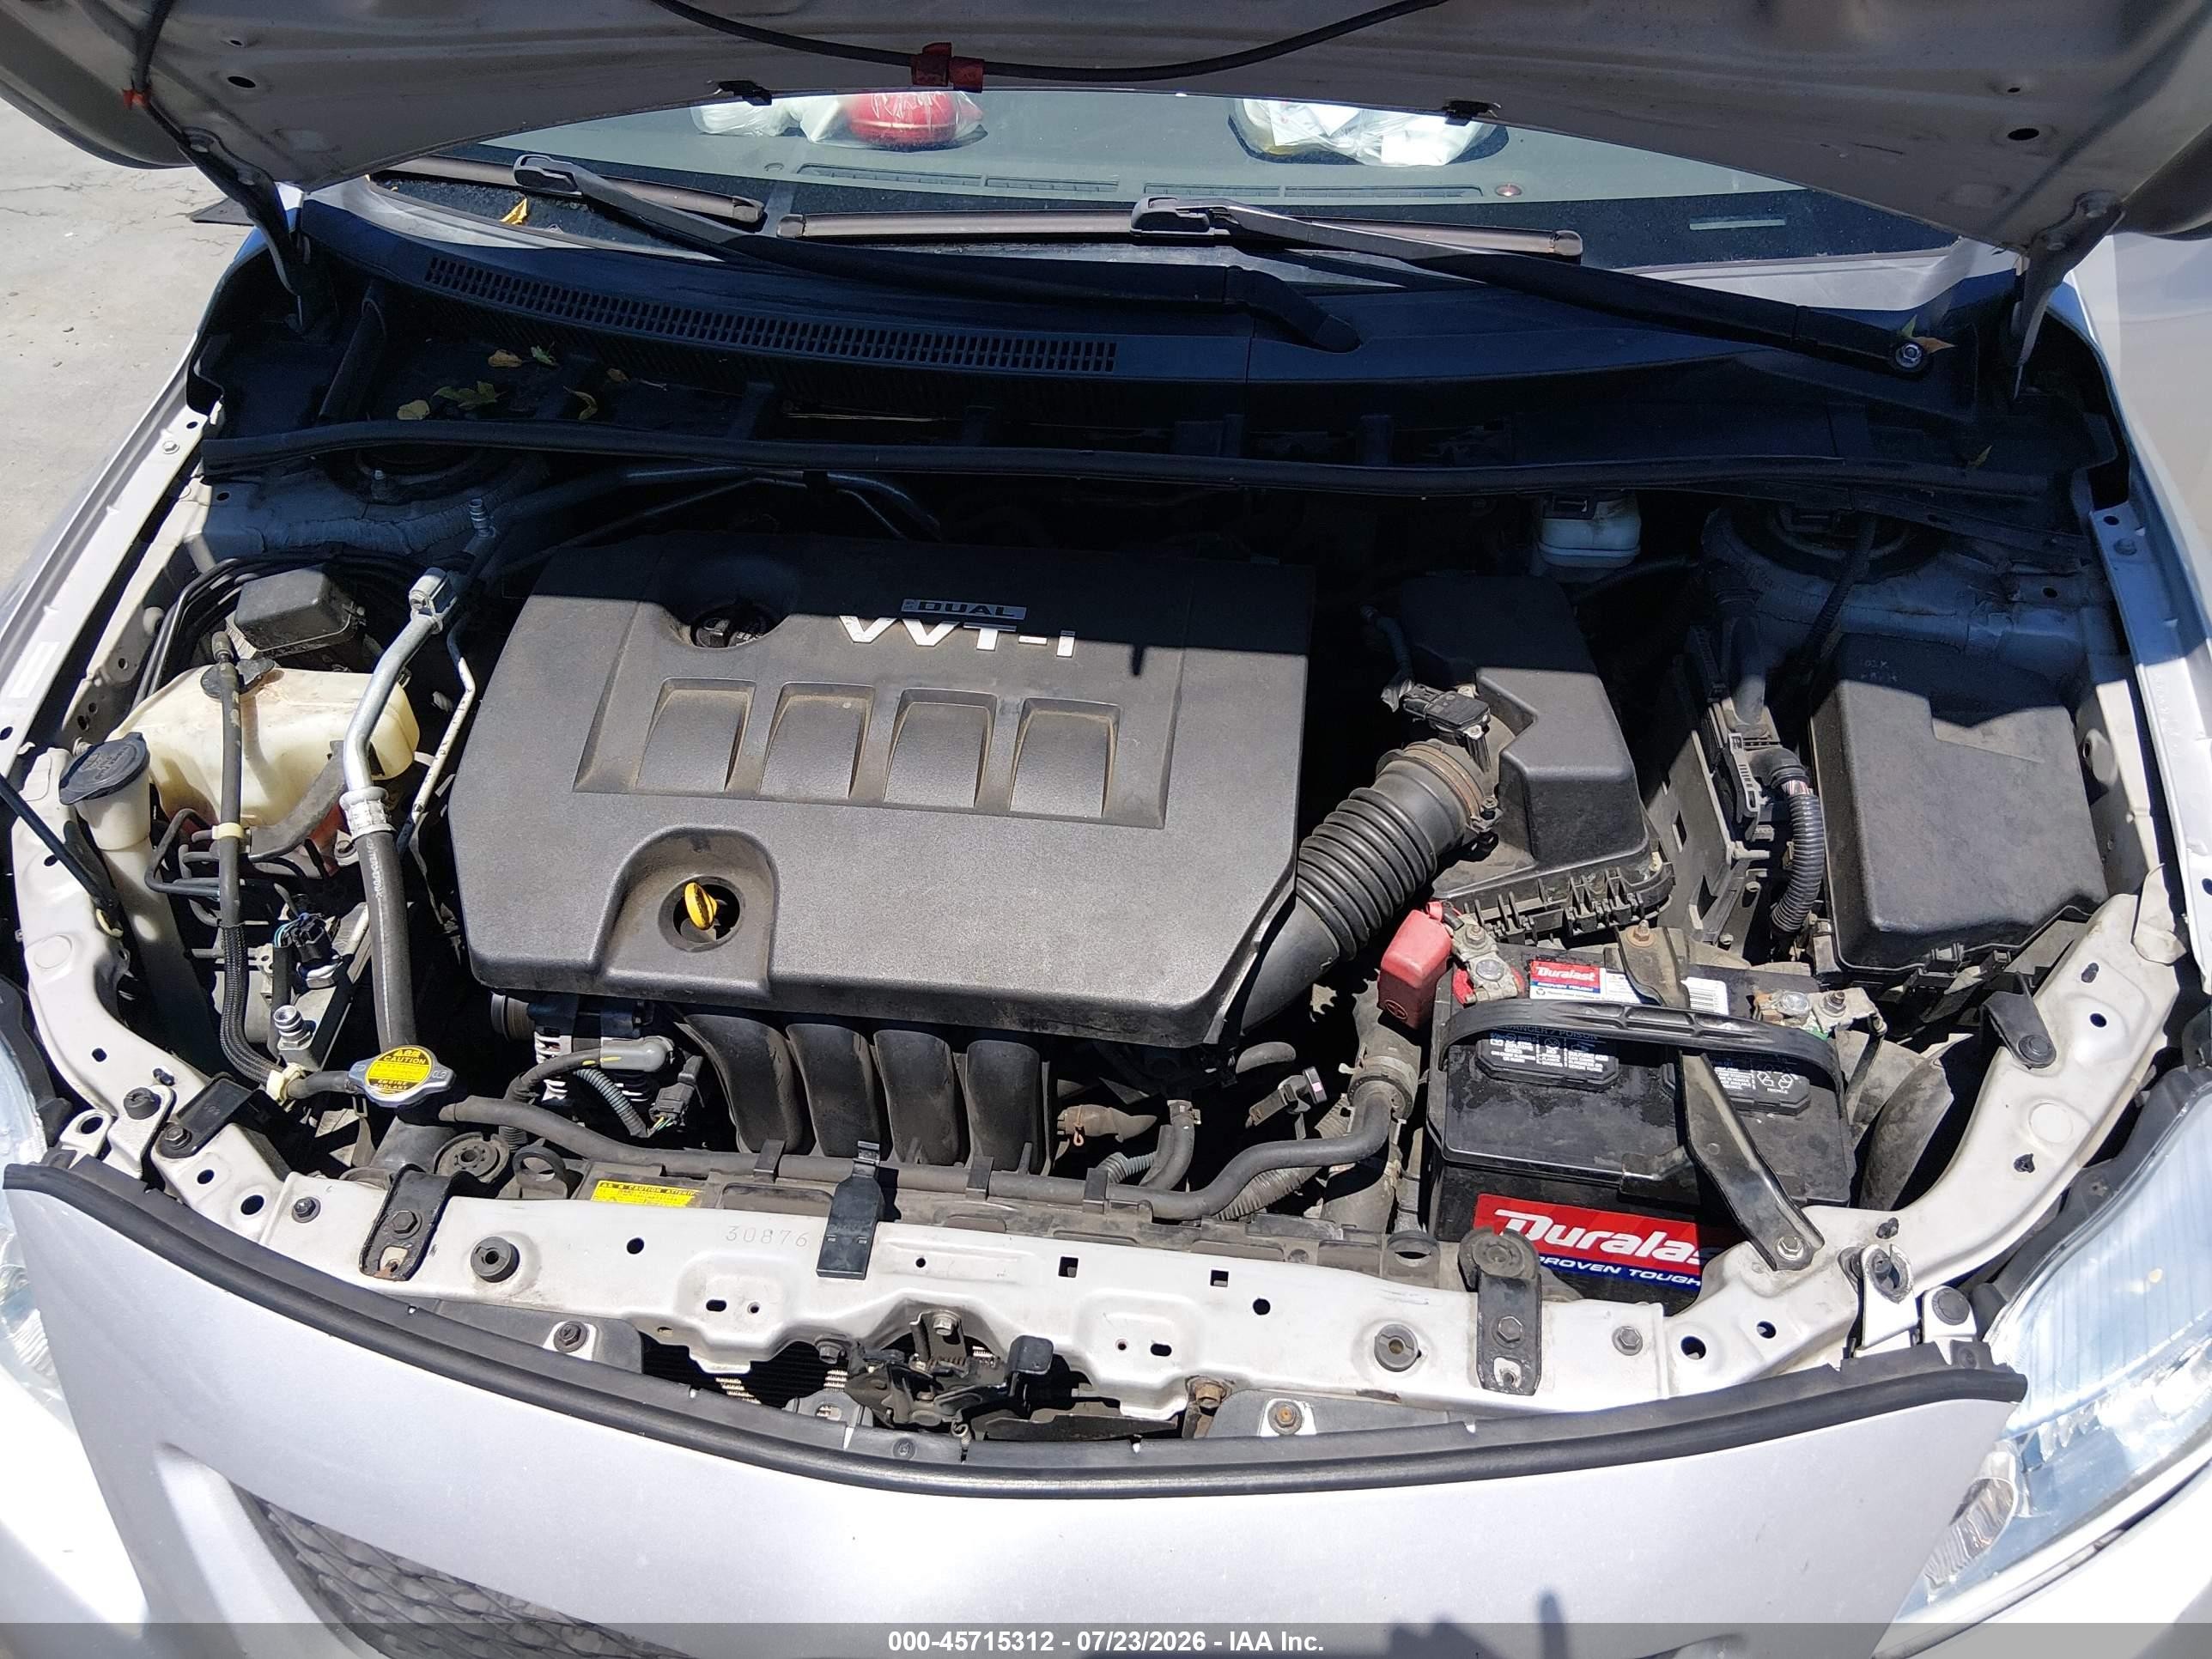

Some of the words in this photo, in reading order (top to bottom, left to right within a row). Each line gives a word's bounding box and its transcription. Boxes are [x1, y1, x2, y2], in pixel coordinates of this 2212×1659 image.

[919, 602, 1015, 617] DUAL
[1535, 966, 1595, 981] Duralast
[1559, 1030, 1598, 1040] POISON
[384, 1055, 427, 1065] CAUTION
[629, 1185, 661, 1194] CAUTION
[726, 1224, 810, 1248] 30876
